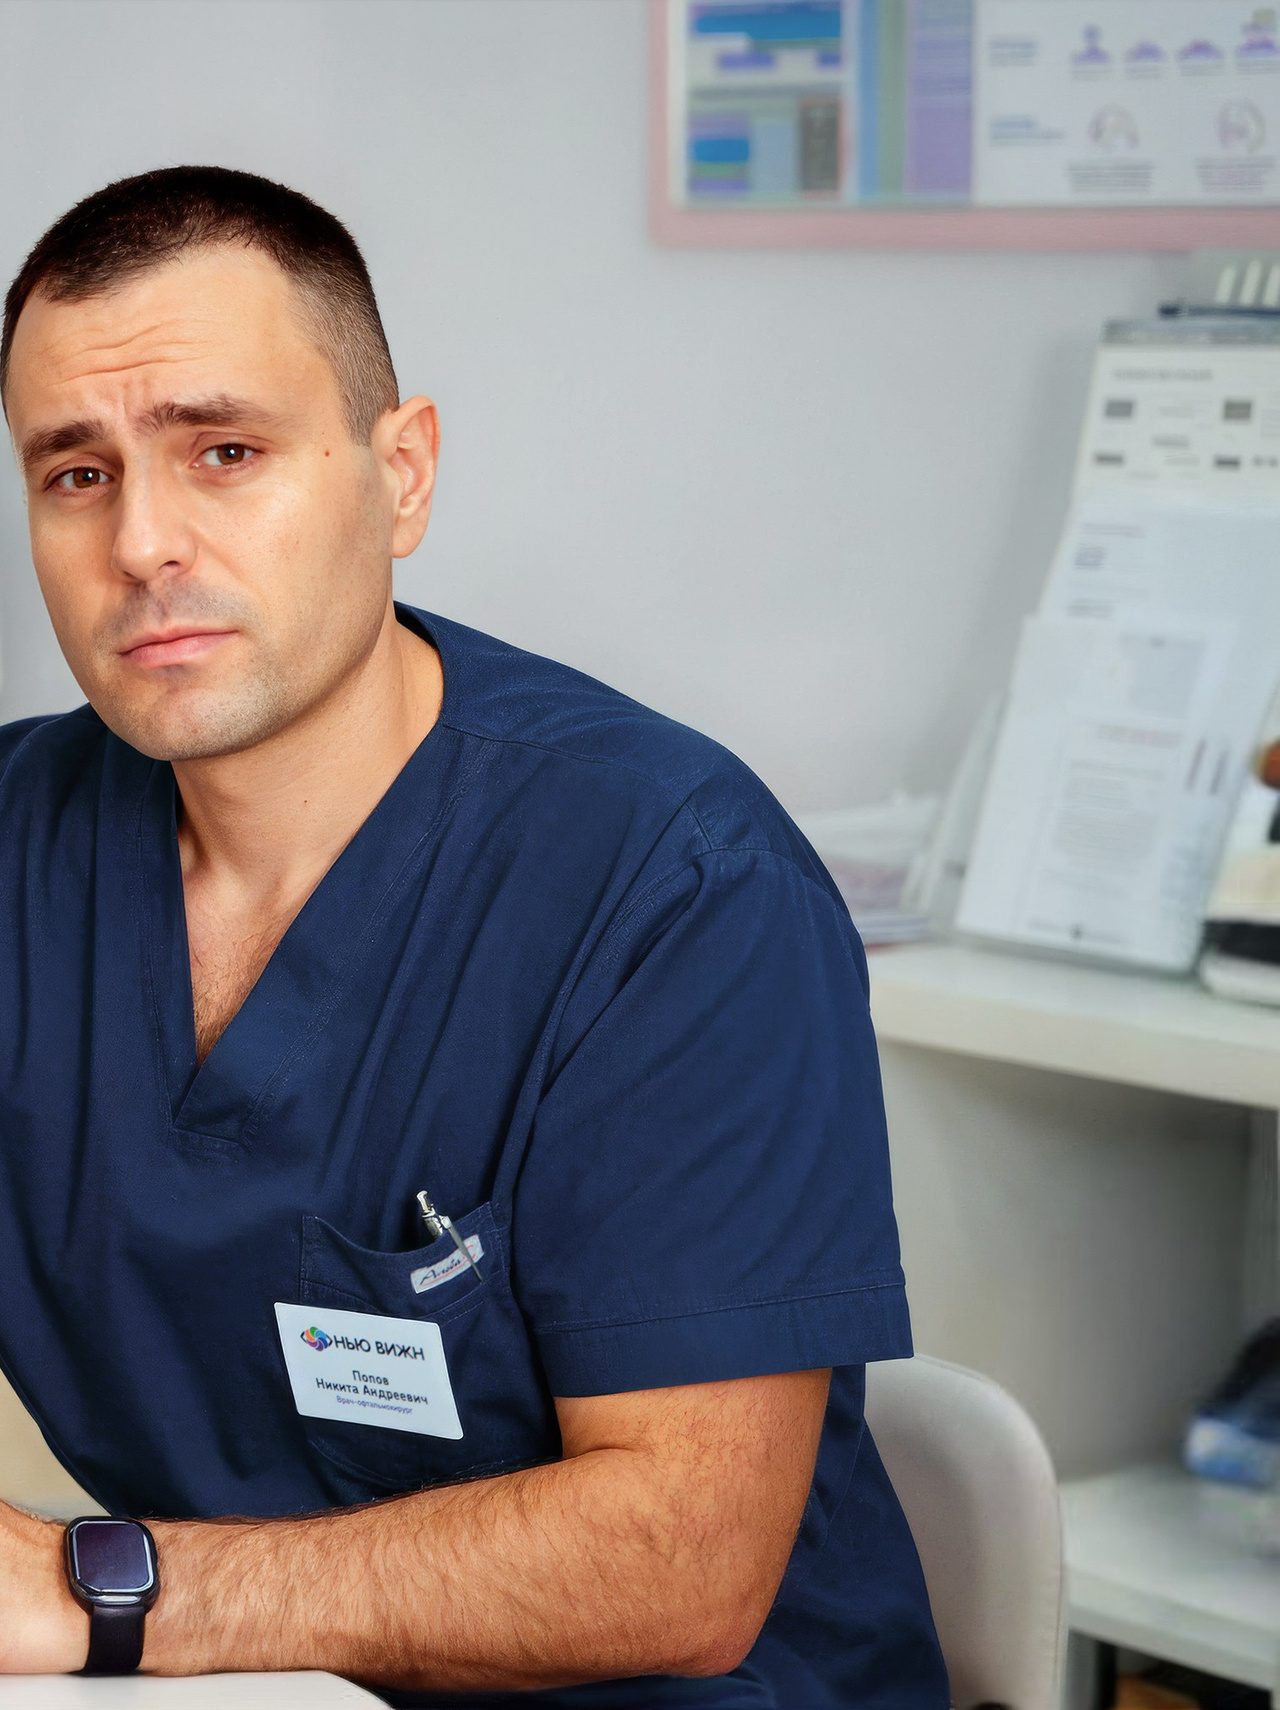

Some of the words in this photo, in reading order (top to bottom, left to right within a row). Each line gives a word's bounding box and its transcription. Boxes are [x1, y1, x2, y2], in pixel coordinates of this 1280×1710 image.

[333, 1335, 371, 1353] НЬЮ
[375, 1341, 425, 1361] ВИЖН
[316, 1377, 359, 1394] Никита
[363, 1385, 429, 1404] Андреевич
[352, 1370, 389, 1386] Попов
